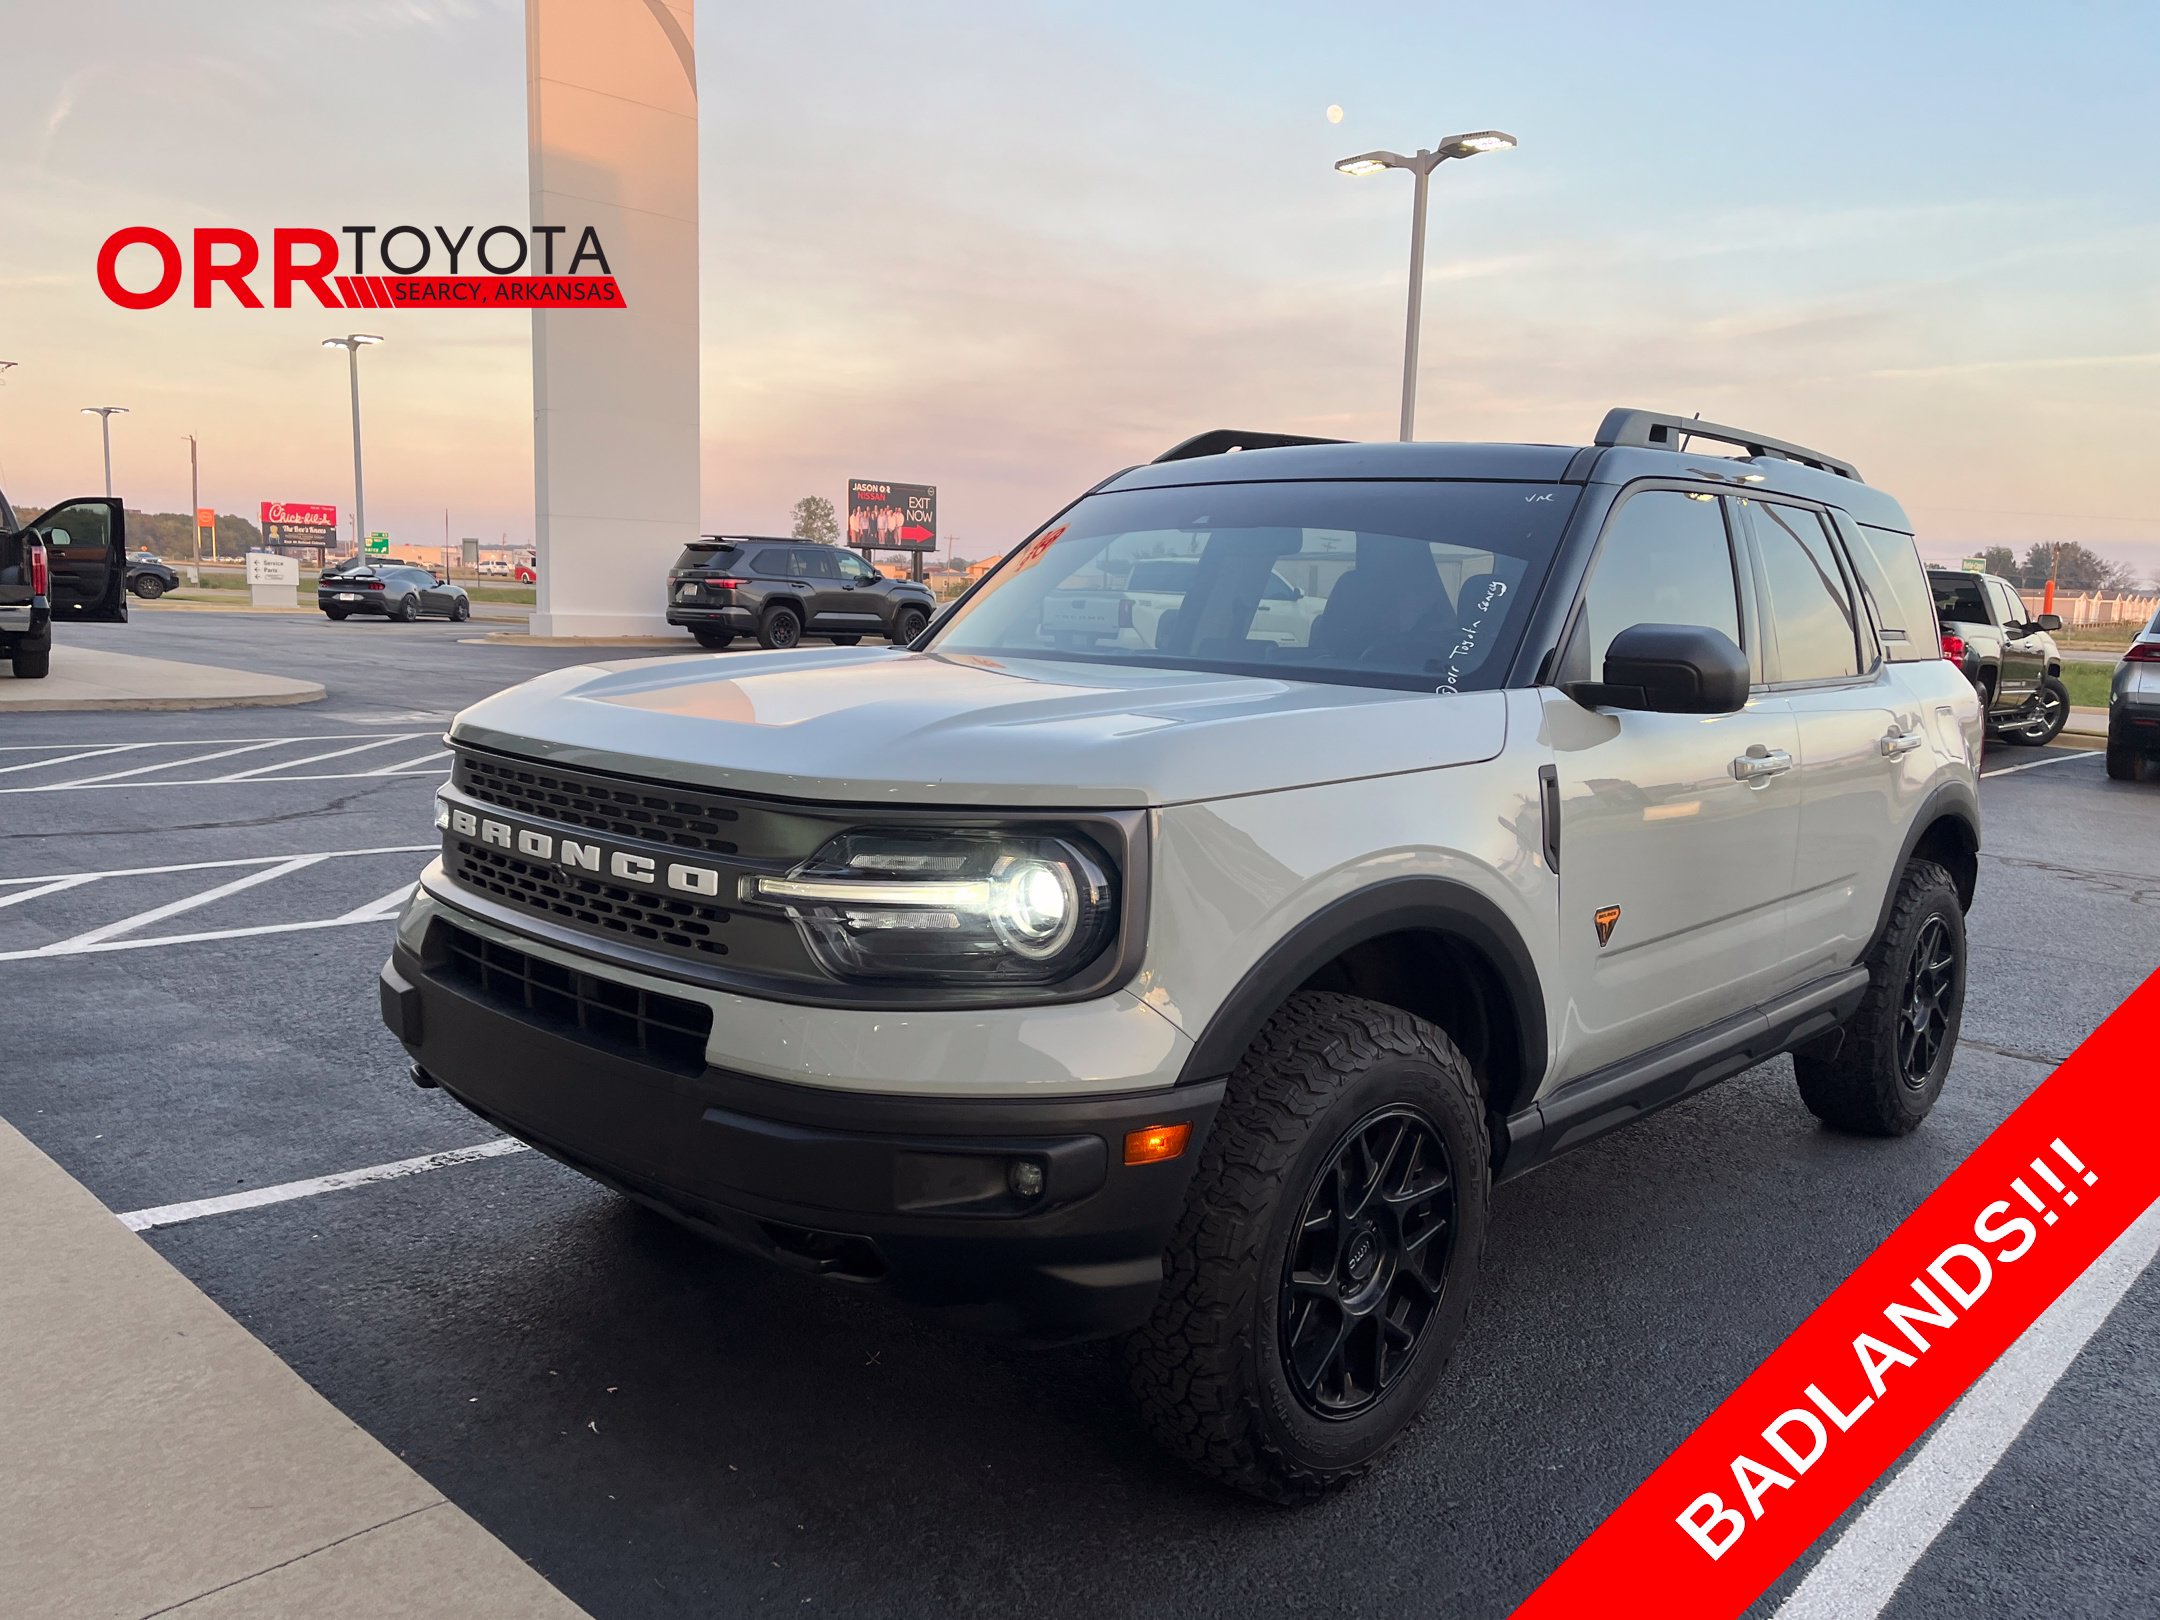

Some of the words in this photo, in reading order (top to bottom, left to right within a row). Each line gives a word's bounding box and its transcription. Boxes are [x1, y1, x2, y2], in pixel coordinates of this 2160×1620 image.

[852, 483, 878, 492] JASON
[857, 491, 886, 501] NISSAN
[909, 496, 931, 509] EXIT
[906, 509, 933, 523] NOW
[452, 809, 719, 897] BRONCO
